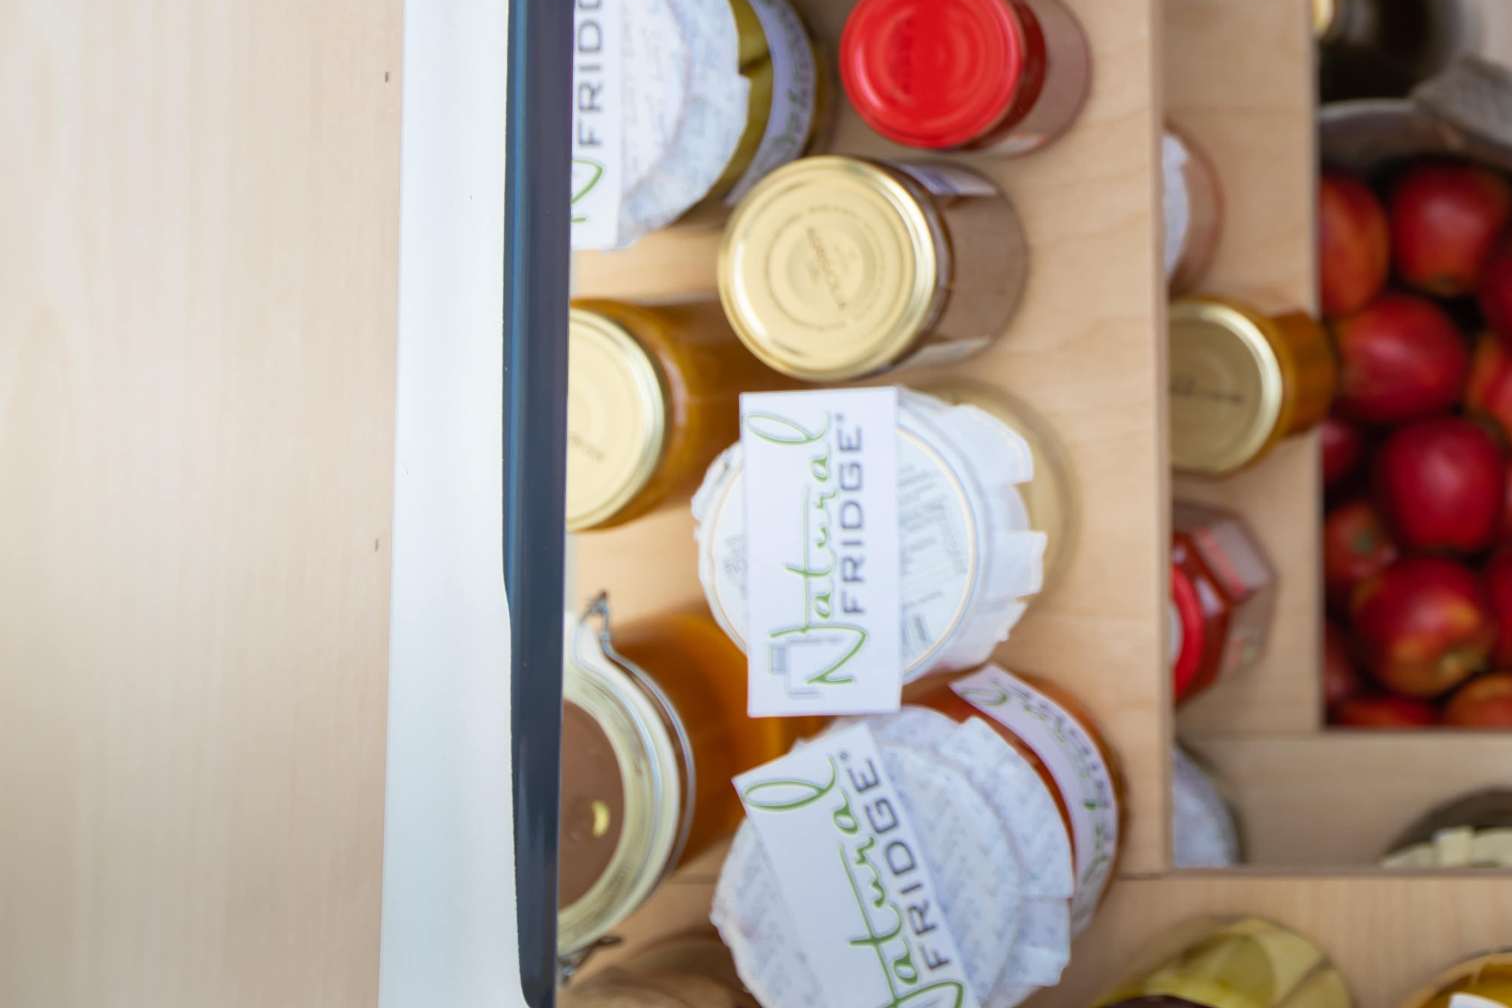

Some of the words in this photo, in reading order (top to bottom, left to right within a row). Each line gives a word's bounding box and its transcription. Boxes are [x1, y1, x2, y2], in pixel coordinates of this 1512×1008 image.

[747, 410, 869, 686] Natural
[838, 425, 866, 615] FRIDGE
[847, 758, 951, 972] FRIDGE
